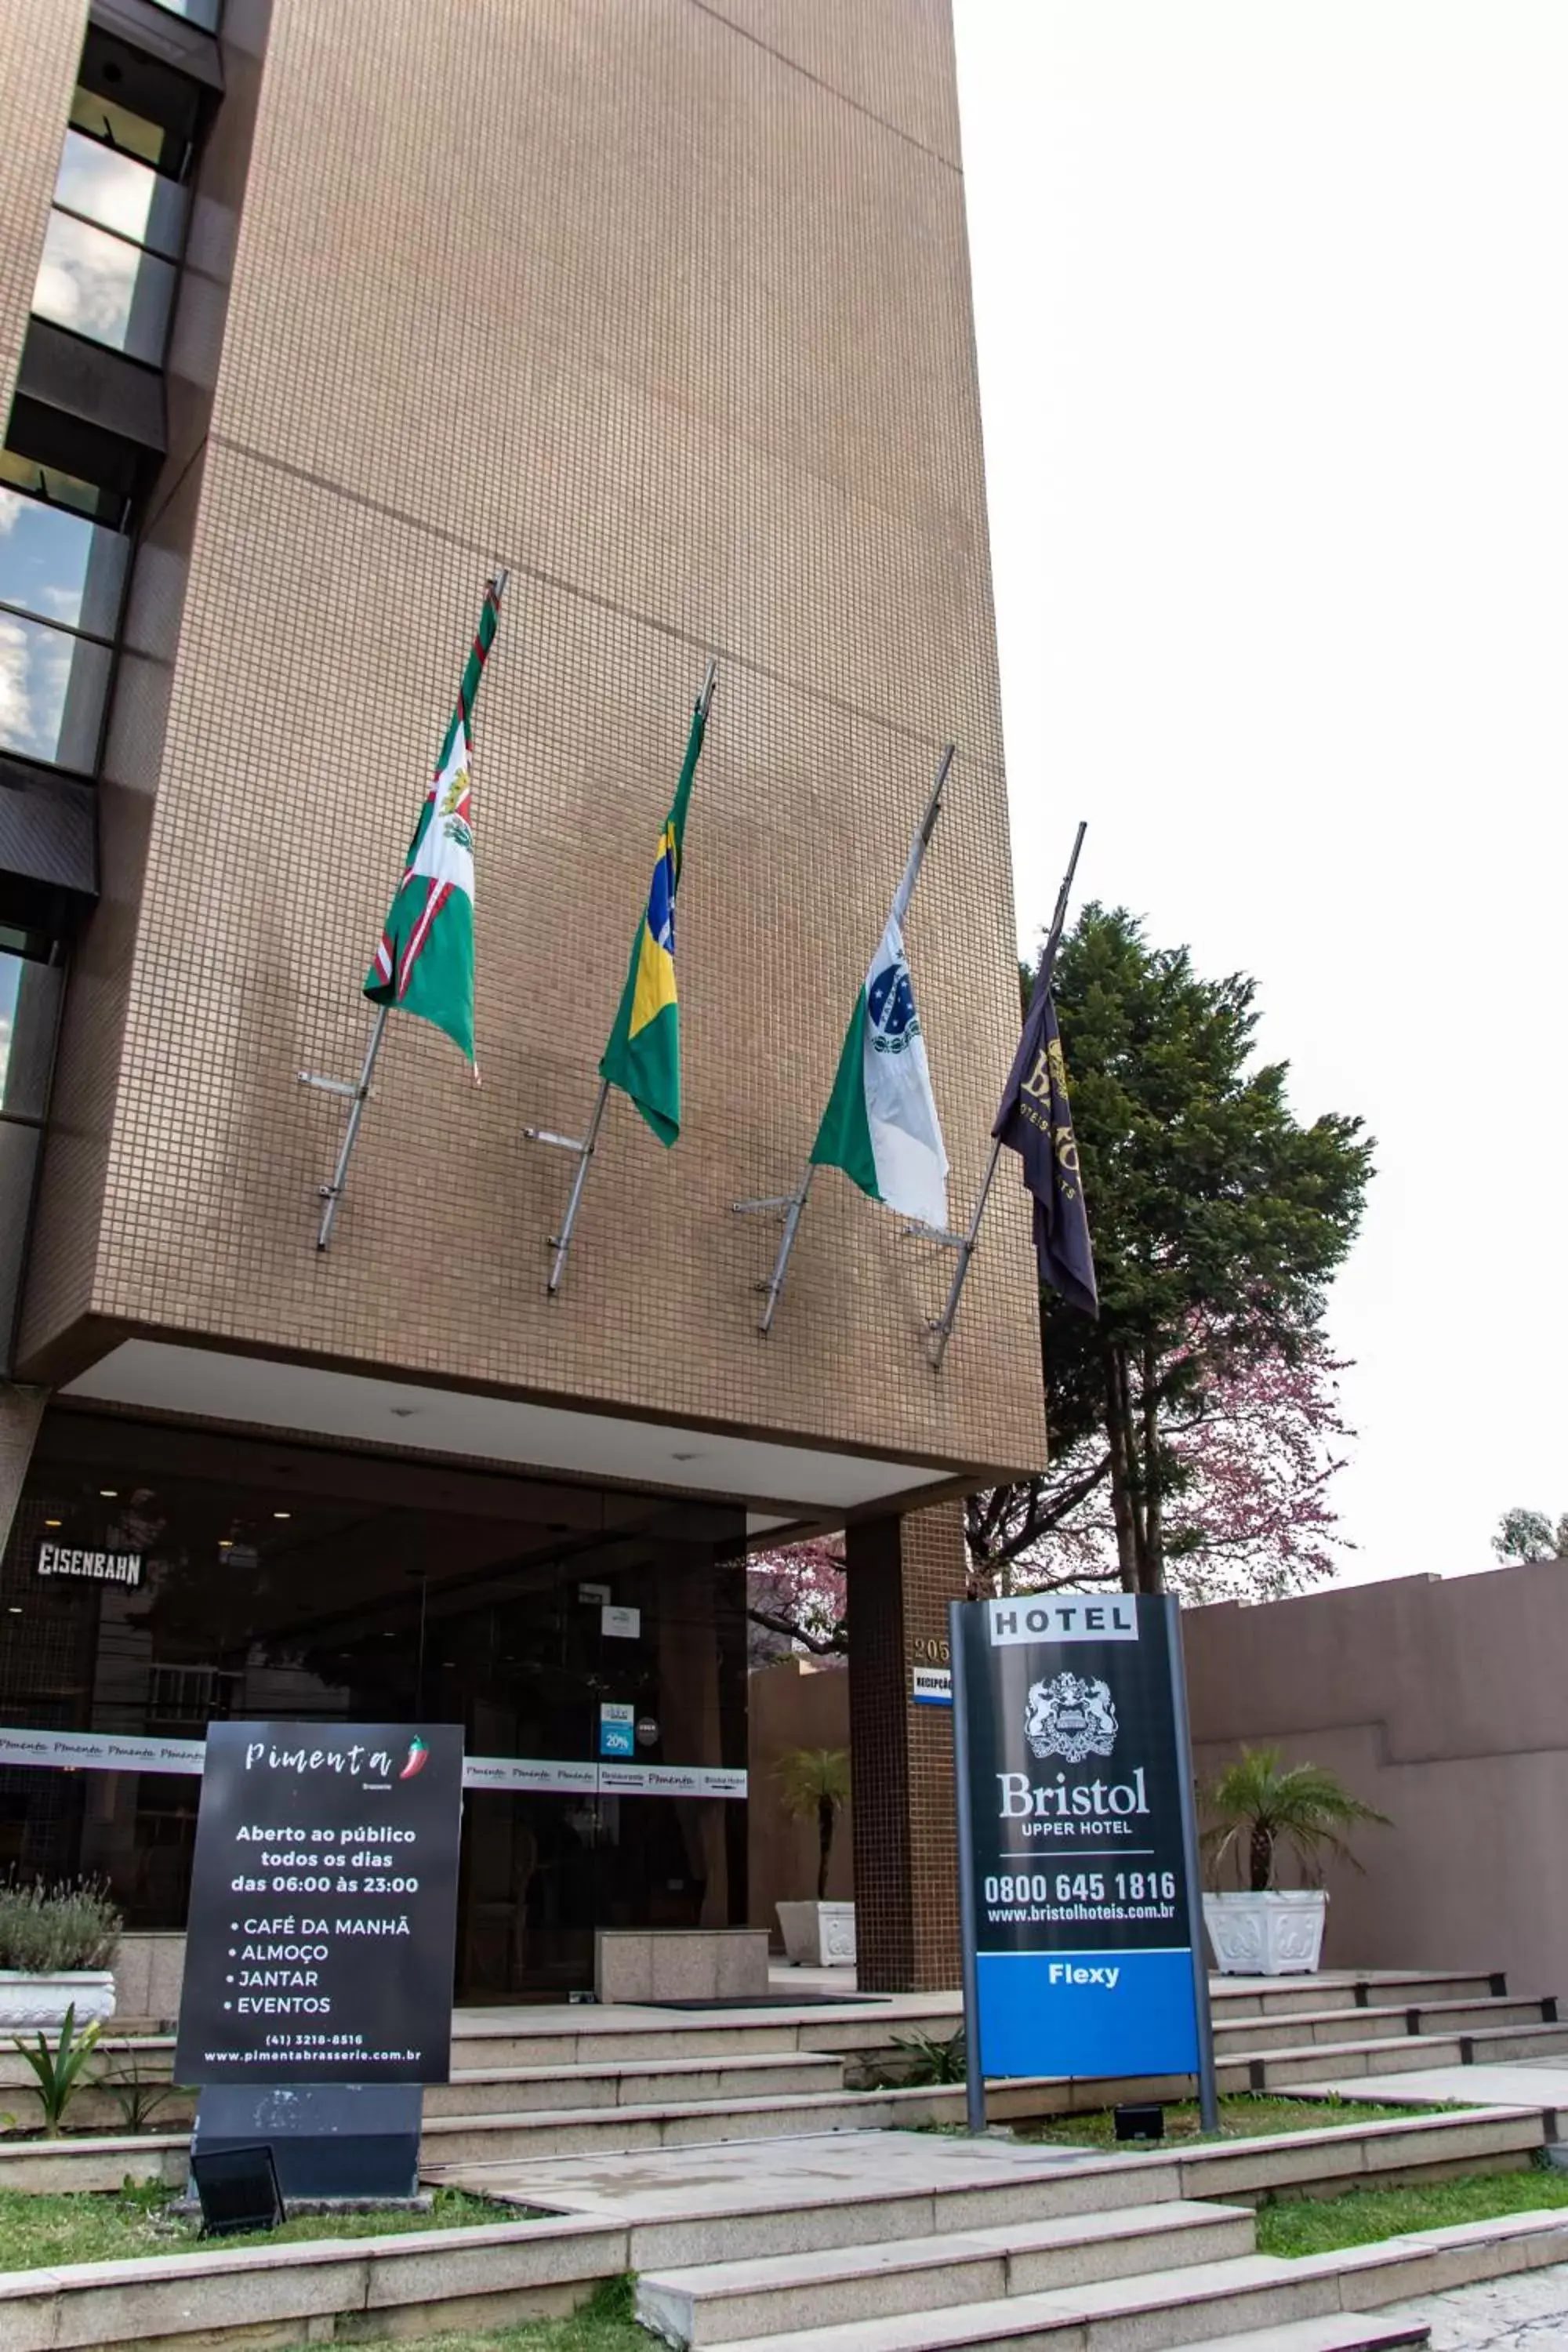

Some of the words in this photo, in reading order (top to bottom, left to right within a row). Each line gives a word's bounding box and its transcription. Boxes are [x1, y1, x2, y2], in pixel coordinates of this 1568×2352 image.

[38, 1542, 140, 1585] EISENBAHN
[996, 1607, 1131, 1635] HOTEL
[915, 1638, 949, 1661] 205
[245, 1743, 393, 1777] Pimenta
[996, 1767, 1150, 1818] Bristol
[236, 1825, 307, 1842] Aberto
[310, 1829, 335, 1842] ao
[340, 1826, 417, 1846] público
[1022, 1822, 1076, 1837] UPPER
[1080, 1821, 1133, 1835] HOTEL
[261, 1851, 318, 1867] todos
[324, 1854, 346, 1867] os
[351, 1851, 393, 1867] dias
[231, 1875, 267, 1892] das
[272, 1877, 330, 1893] 06:00
[336, 1876, 358, 1893] às
[363, 1878, 419, 1893] 23:00
[985, 1875, 1047, 1903] 0800
[1056, 1873, 1105, 1901] 645
[1115, 1871, 1176, 1900] 1816
[988, 1903, 1175, 1922] www.bristolhoteis.com.br
[244, 1915, 296, 1935] CAFÉ
[301, 1918, 330, 1935] DA
[335, 1915, 411, 1935] MANHÃ
[241, 1944, 328, 1964] ALMOÇO
[238, 1970, 318, 1987] JANTAR
[1048, 1963, 1120, 1989] Flexy
[238, 1997, 331, 2013] EVENTOS
[266, 2034, 291, 2047] (41)
[295, 2034, 363, 2045] 3218-8516
[204, 2049, 422, 2063] www.pimentabrasserie.com.br
